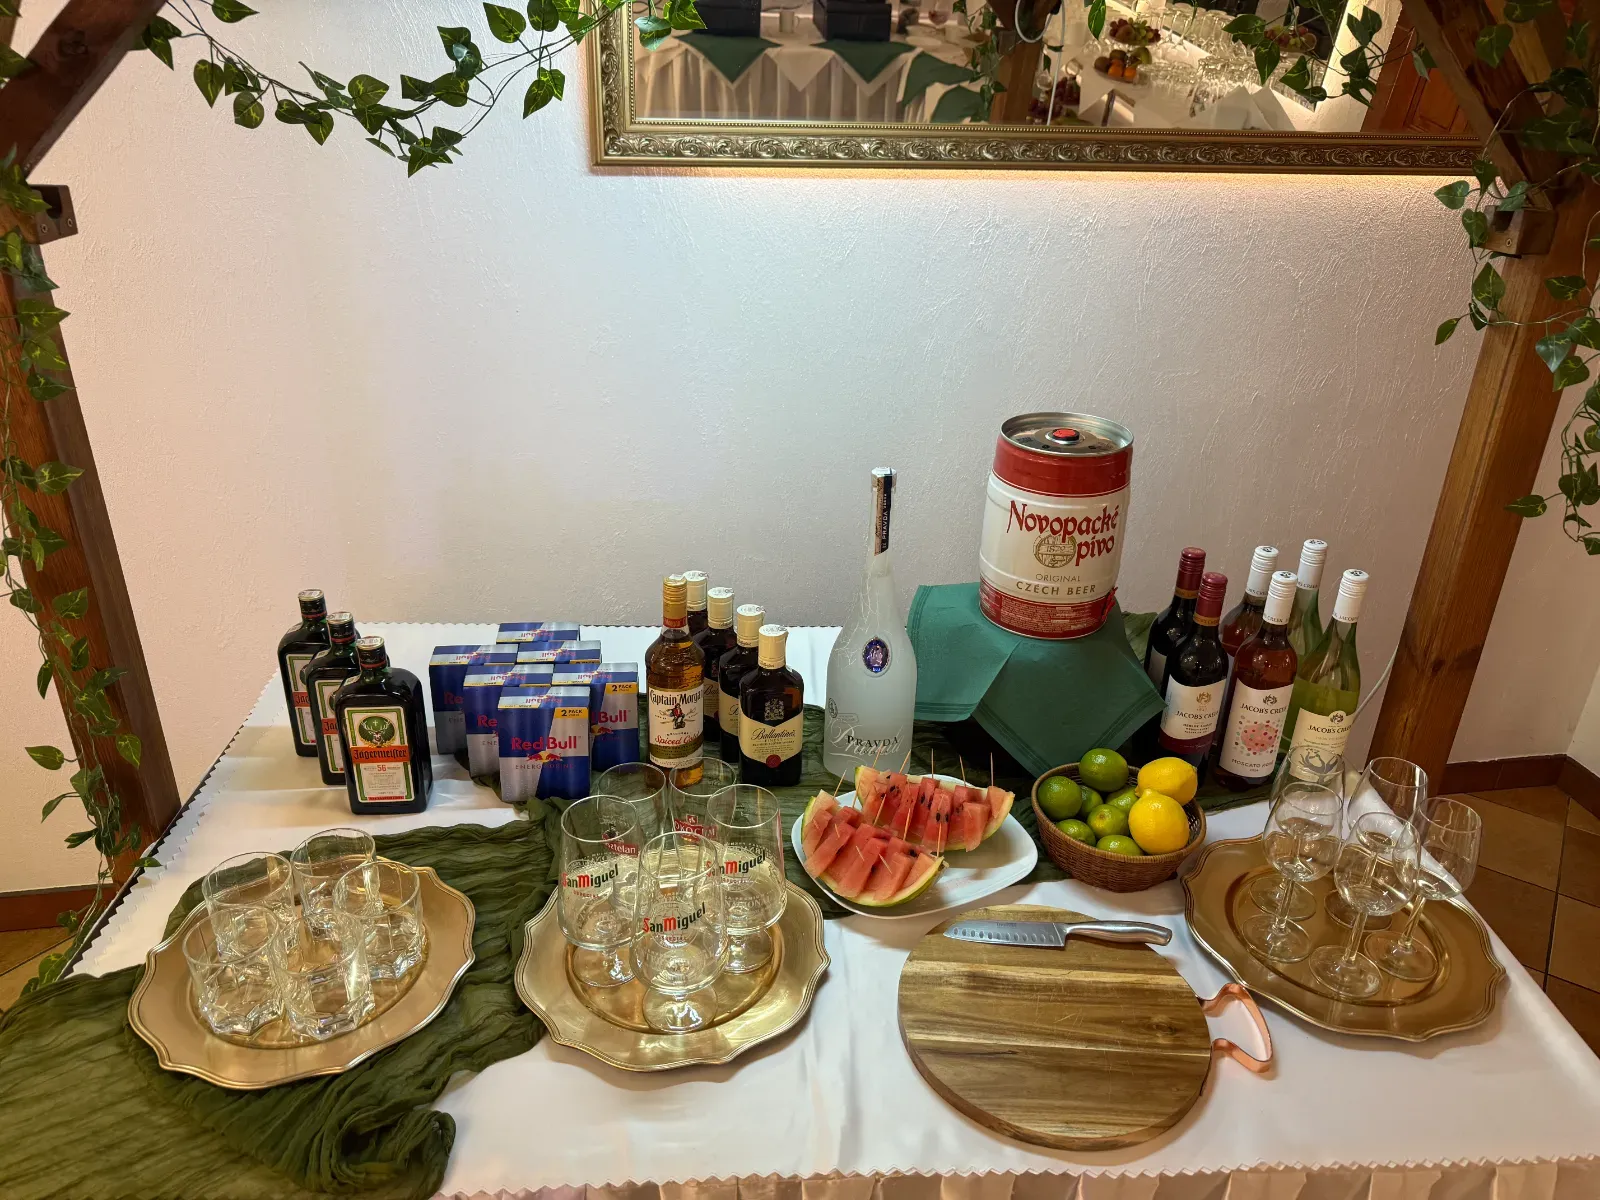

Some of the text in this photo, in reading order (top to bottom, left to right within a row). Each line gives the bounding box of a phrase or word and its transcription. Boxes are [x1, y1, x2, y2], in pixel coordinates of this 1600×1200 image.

[1006, 499, 1120, 544] Novopacké
[1035, 573, 1081, 583] ORIGINAL
[1016, 581, 1096, 596] CZECH BEER
[611, 684, 618, 692] 2
[443, 691, 464, 704] Re
[649, 689, 677, 706] Captain
[560, 709, 567, 717] 2
[599, 709, 627, 723] Bull
[477, 714, 498, 727] Re
[511, 735, 577, 751] Red Bull
[654, 734, 683, 745] Spiced
[846, 735, 899, 748] PRAVDA
[376, 764, 387, 772] 56
[1231, 758, 1260, 768] MOSCATO
